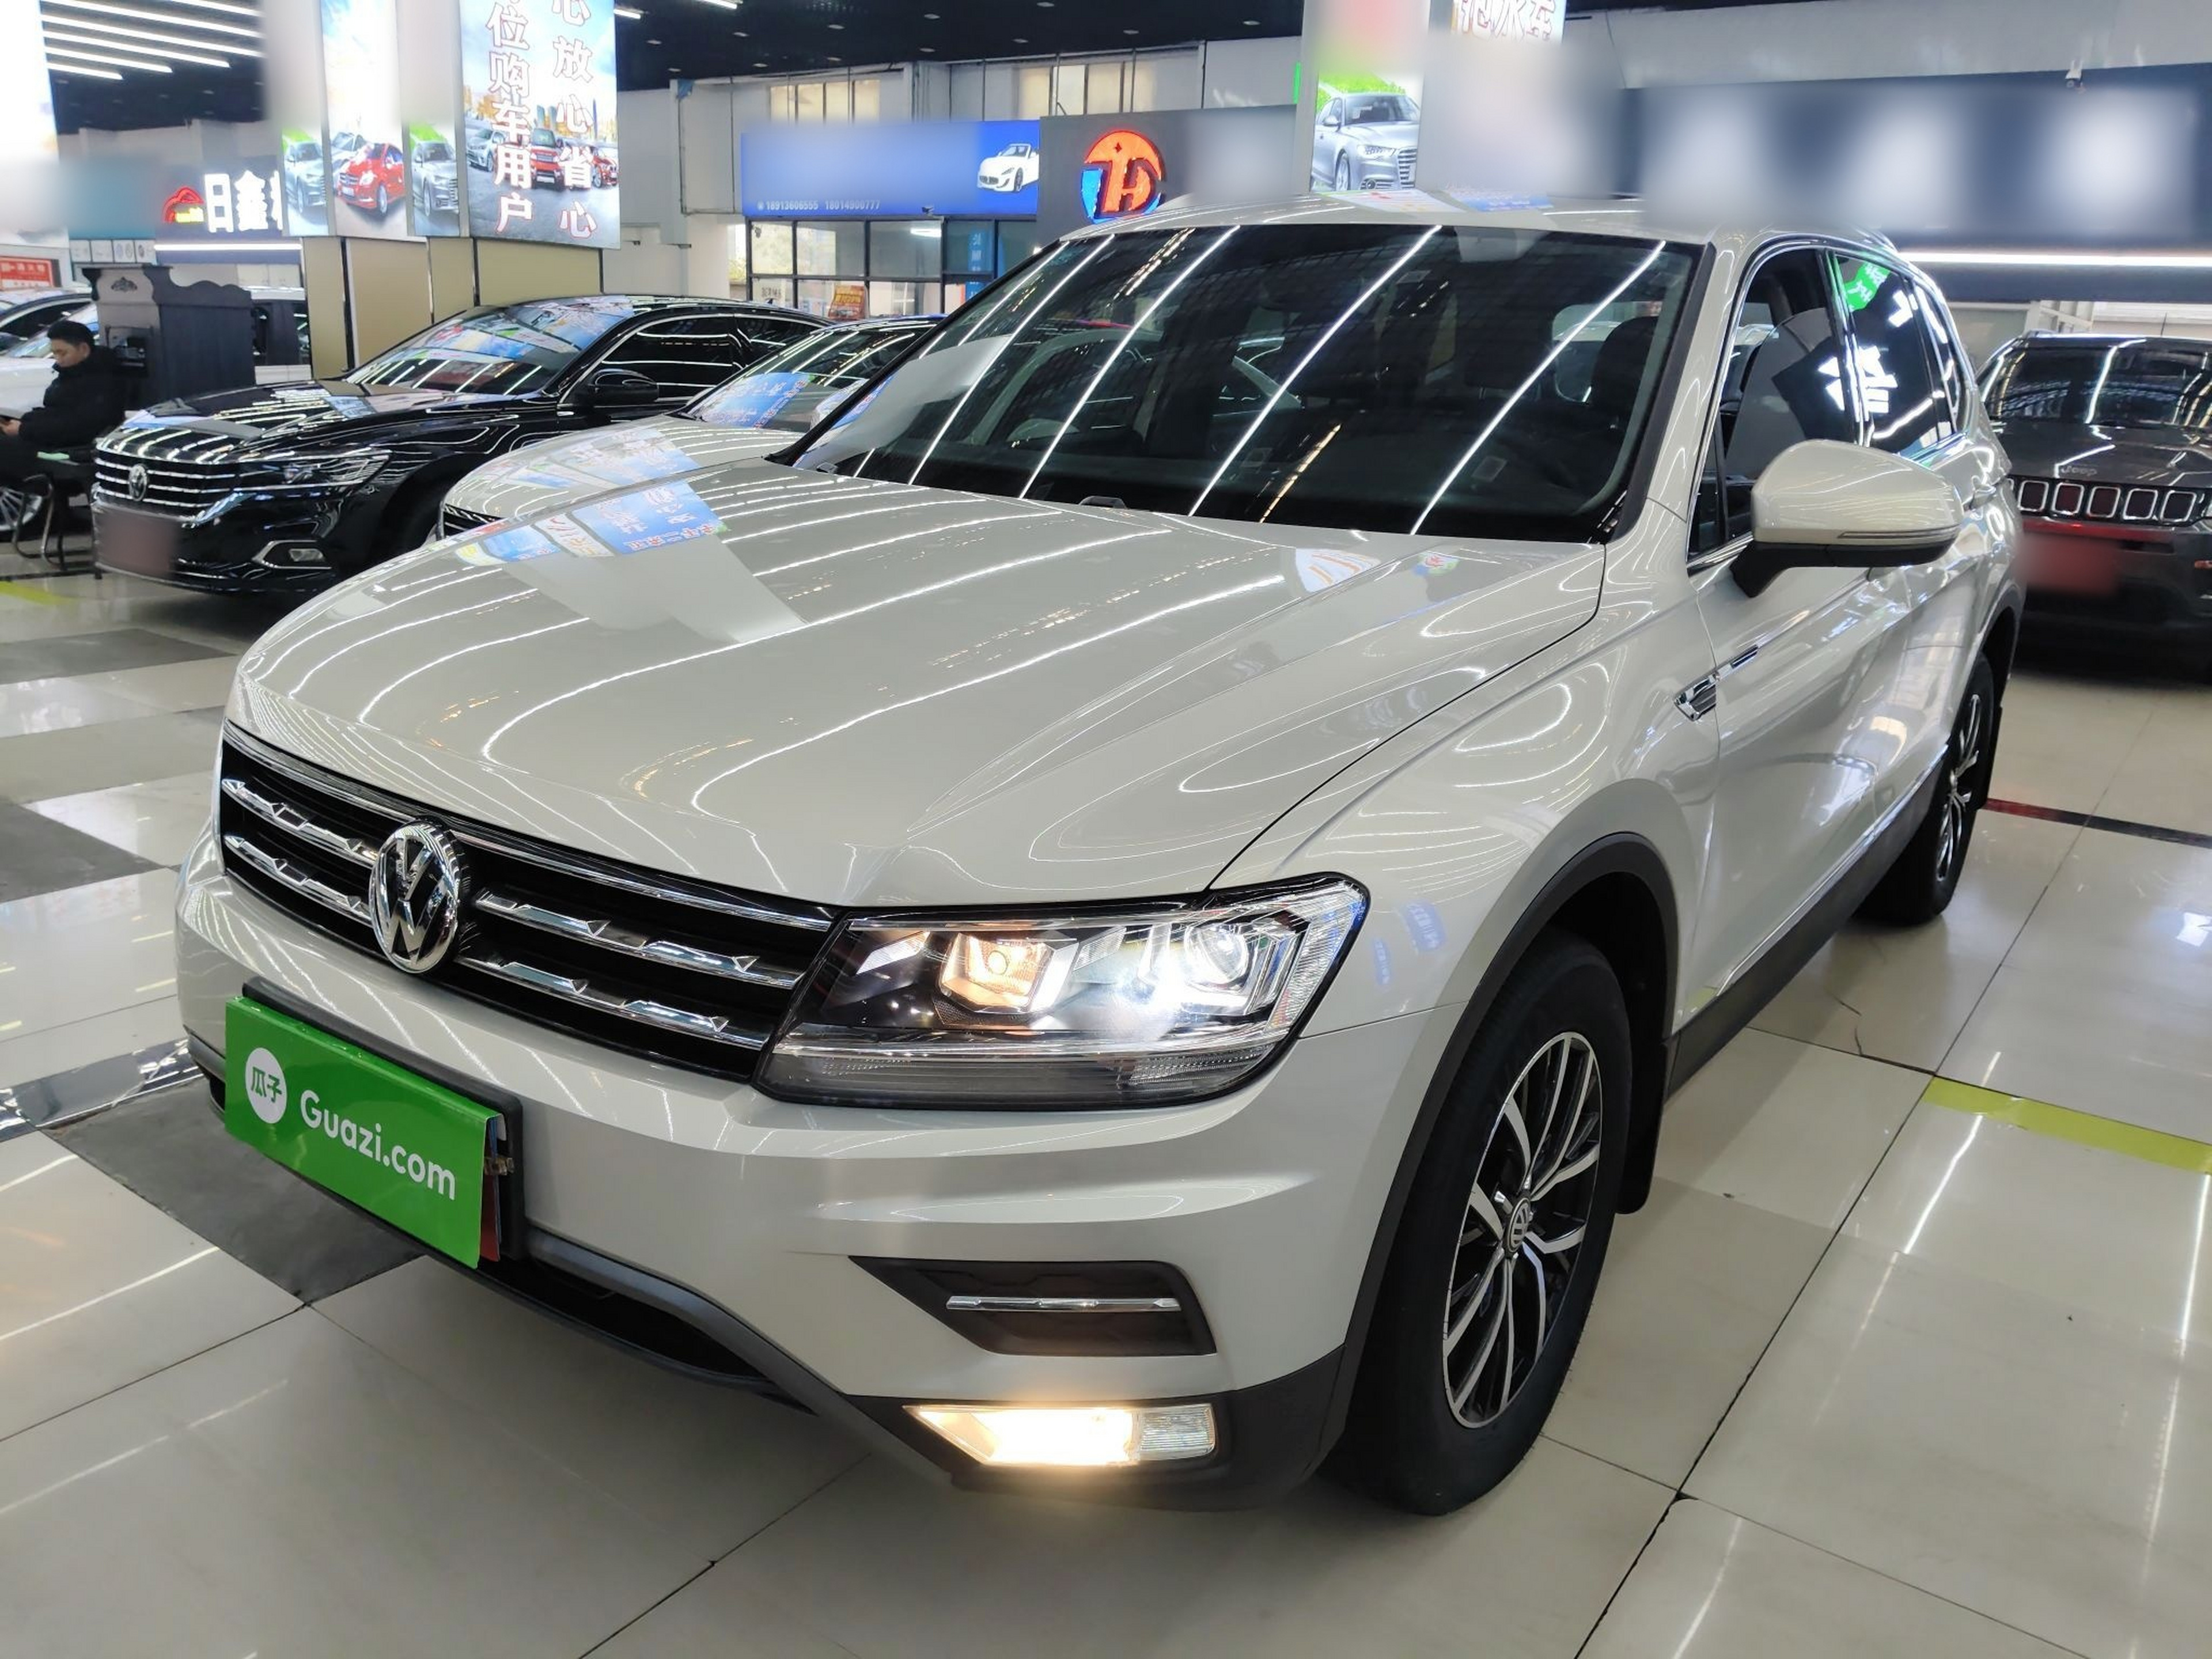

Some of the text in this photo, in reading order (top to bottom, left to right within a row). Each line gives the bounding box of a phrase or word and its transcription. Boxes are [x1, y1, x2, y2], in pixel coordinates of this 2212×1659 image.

[486, 0, 533, 233] 位购车用户
[551, 0, 598, 238] 心放心省心
[251, 1066, 282, 1103] 瓜子
[300, 1089, 456, 1200] Guazi.com
